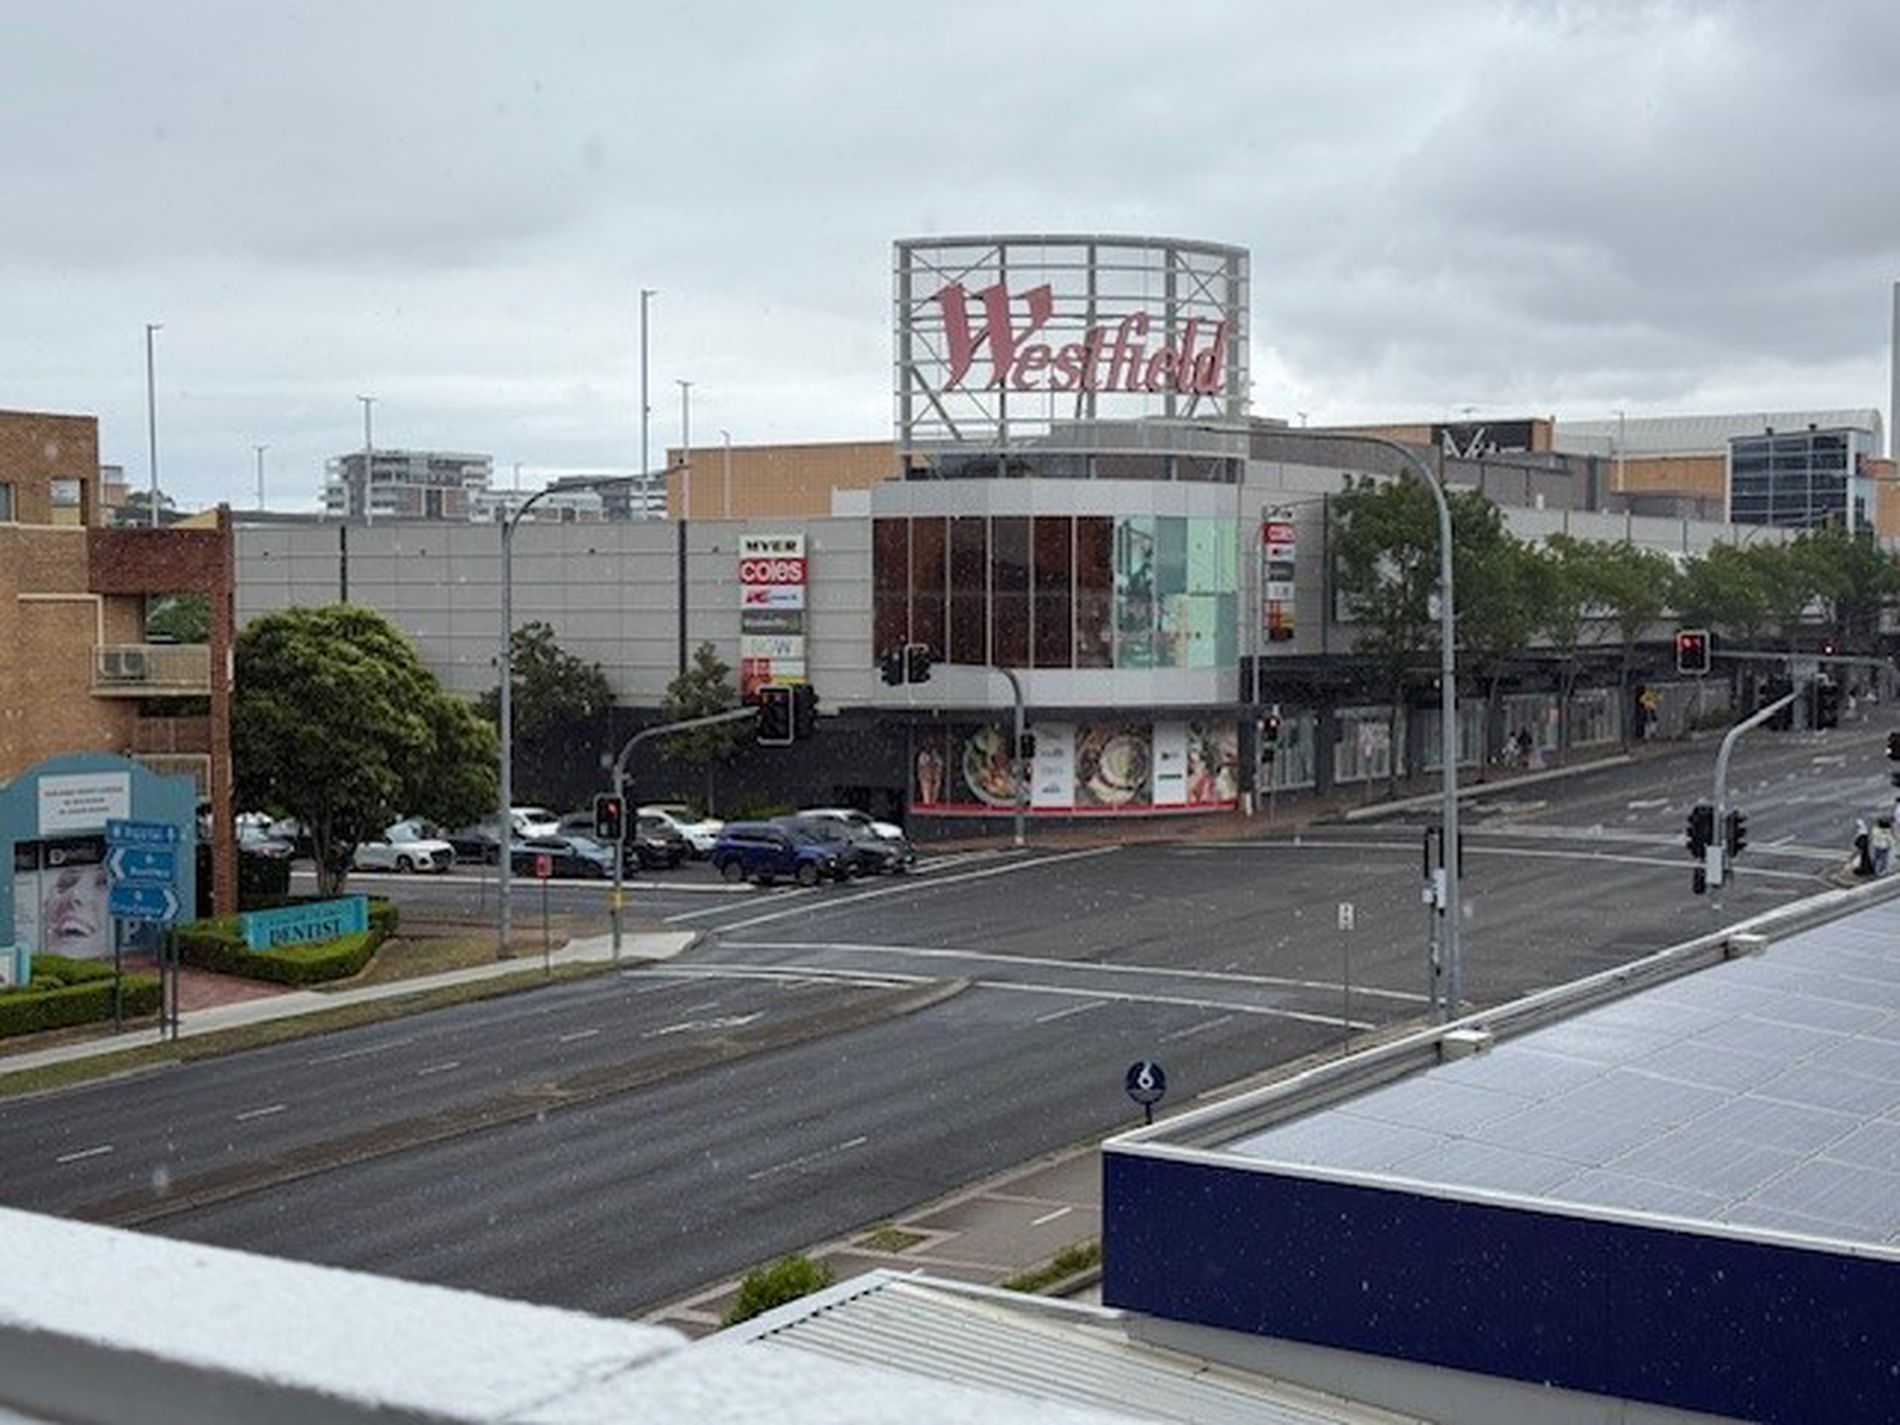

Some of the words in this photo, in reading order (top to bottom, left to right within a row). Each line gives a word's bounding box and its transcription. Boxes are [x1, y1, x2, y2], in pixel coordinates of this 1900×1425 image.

[930, 284, 1230, 393] Westfield
[746, 541, 796, 553] MYER
[741, 561, 803, 582] coles
[269, 920, 341, 945] DENTIST
